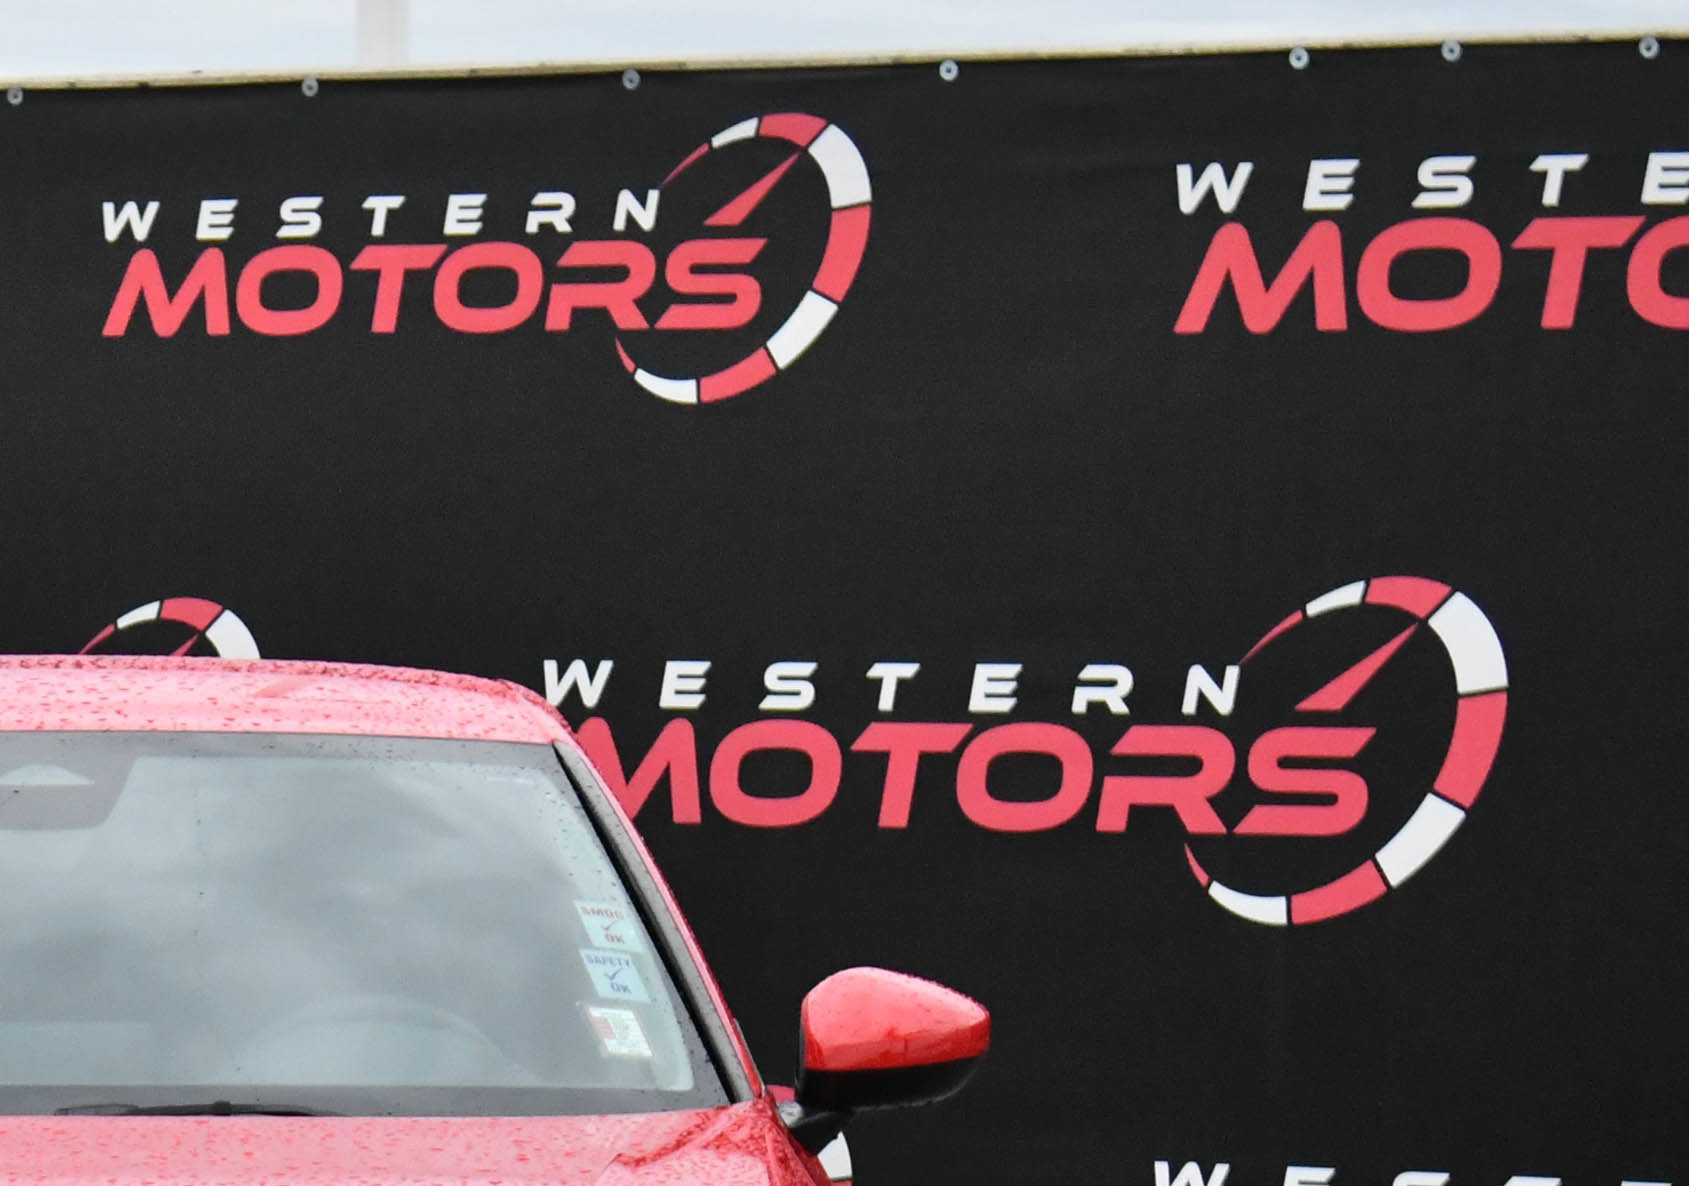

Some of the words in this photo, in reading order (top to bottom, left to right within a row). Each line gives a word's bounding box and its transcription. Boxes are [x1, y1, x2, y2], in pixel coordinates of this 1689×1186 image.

[101, 188, 660, 242] WESTERN
[101, 237, 767, 338] MOTORS
[543, 658, 1240, 716] WESTERN
[574, 716, 1377, 836] MOTORS
